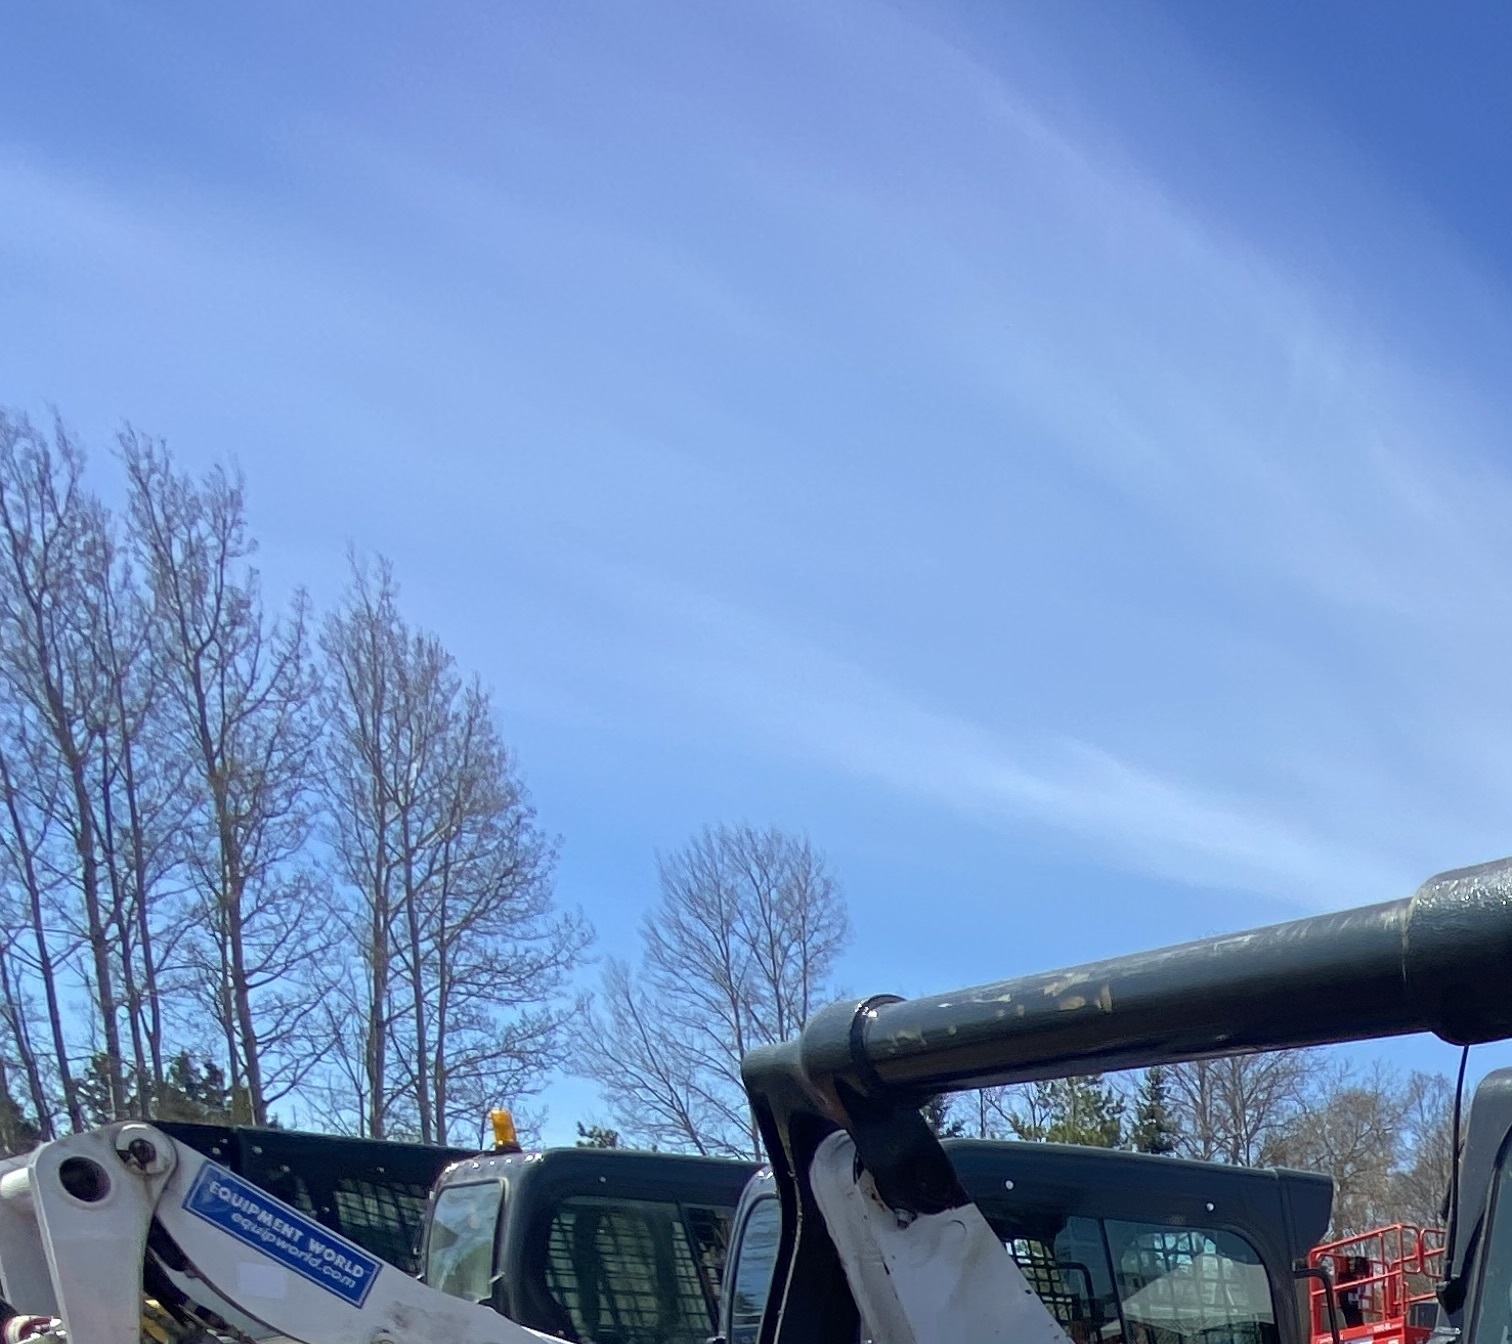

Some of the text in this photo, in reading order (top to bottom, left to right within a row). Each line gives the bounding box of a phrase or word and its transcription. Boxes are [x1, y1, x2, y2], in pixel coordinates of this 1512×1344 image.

[208, 1180, 365, 1278] EQUIPMENT WORLD
[230, 1211, 357, 1289] equipworld.com
